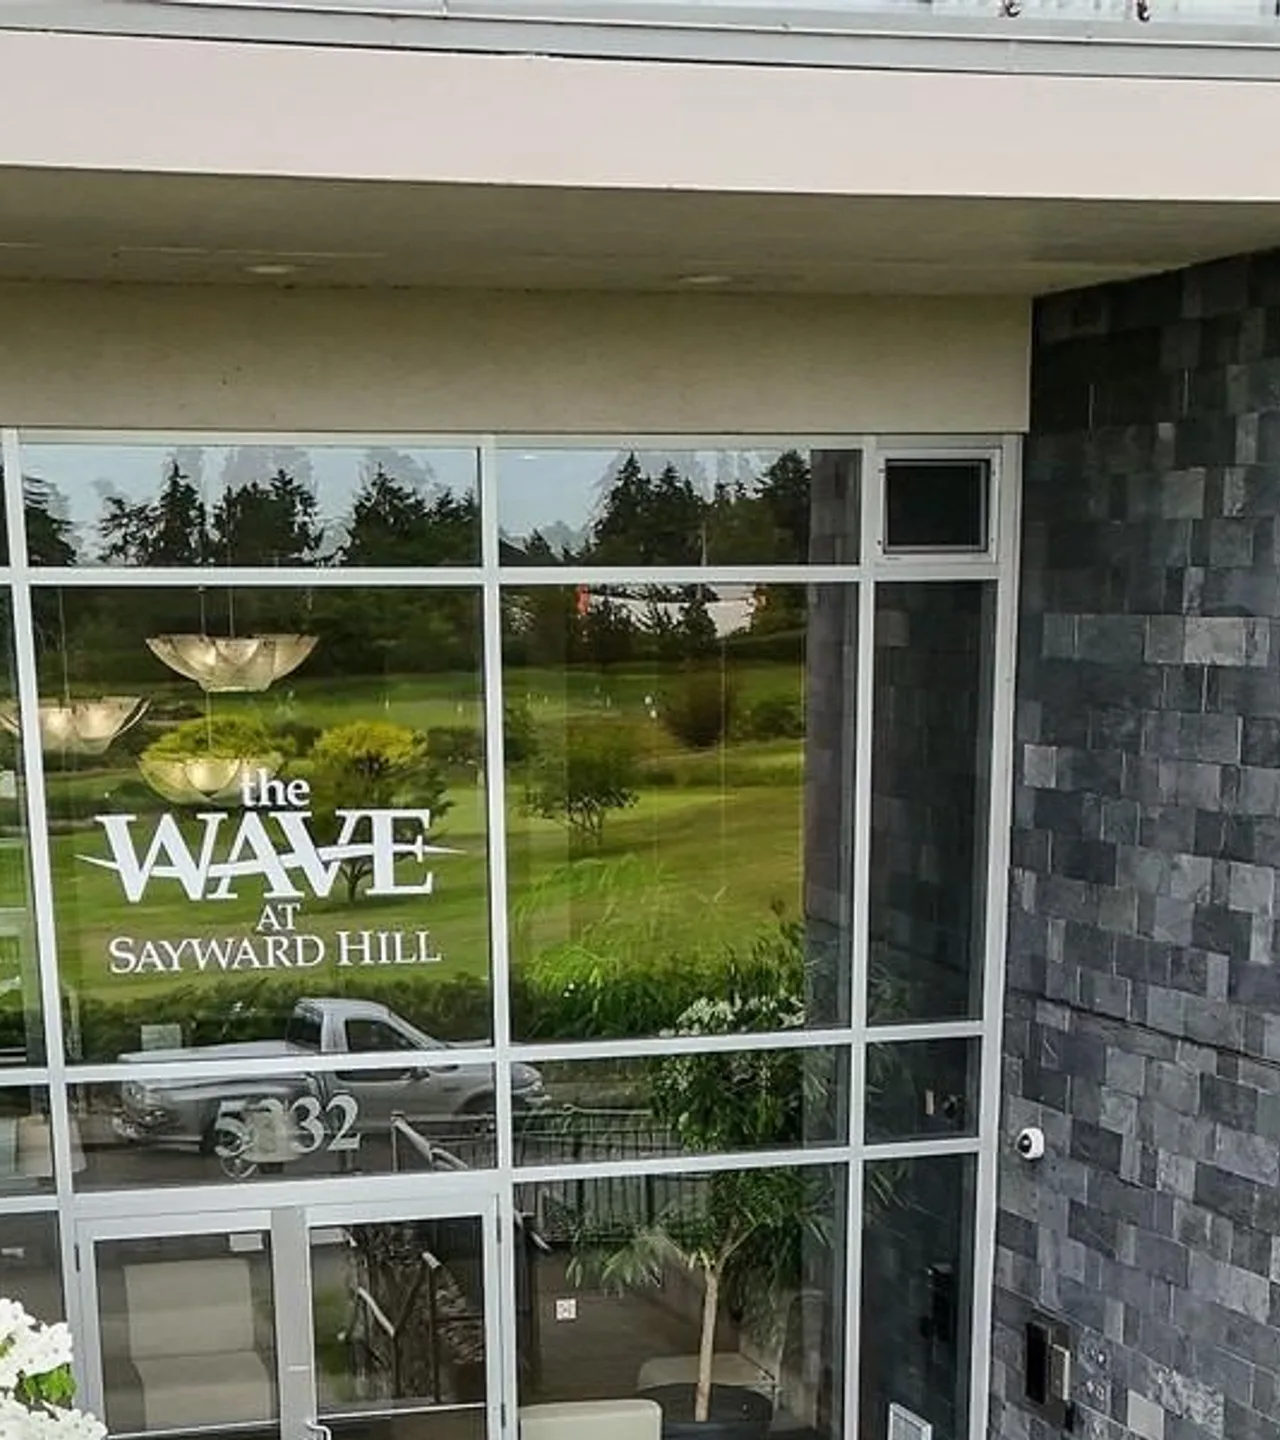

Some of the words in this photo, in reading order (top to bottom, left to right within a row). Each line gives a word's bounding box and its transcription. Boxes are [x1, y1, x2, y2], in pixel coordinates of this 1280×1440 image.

[240, 768, 311, 807] the
[93, 808, 433, 903] WAVE
[256, 903, 301, 932] AT
[108, 935, 325, 974] SAYWARD
[336, 931, 442, 967] HILL
